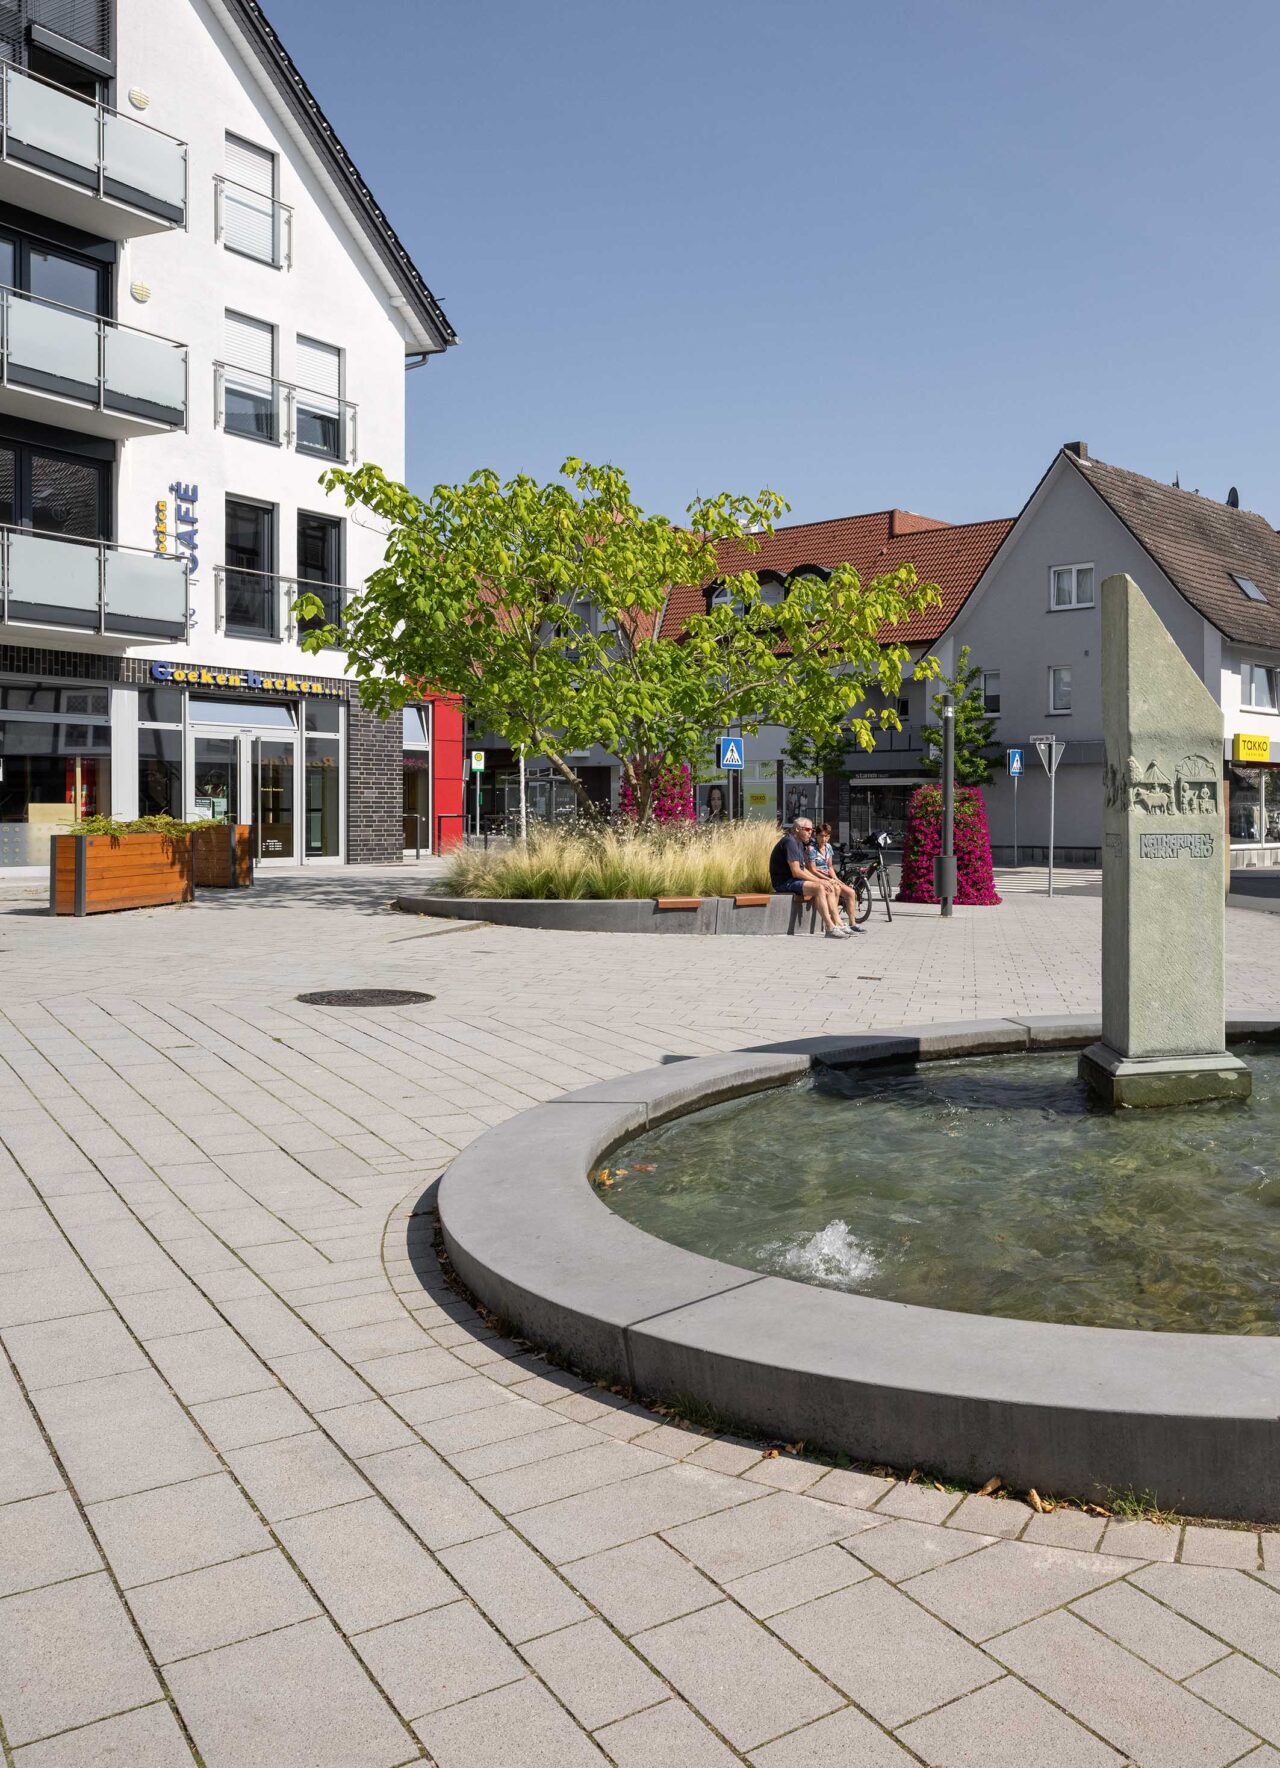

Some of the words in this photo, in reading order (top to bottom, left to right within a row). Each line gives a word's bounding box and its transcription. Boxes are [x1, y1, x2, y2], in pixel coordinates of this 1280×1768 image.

[154, 501, 167, 559] oeken
[152, 661, 241, 686] Goeken
[246, 669, 344, 697] backen...
